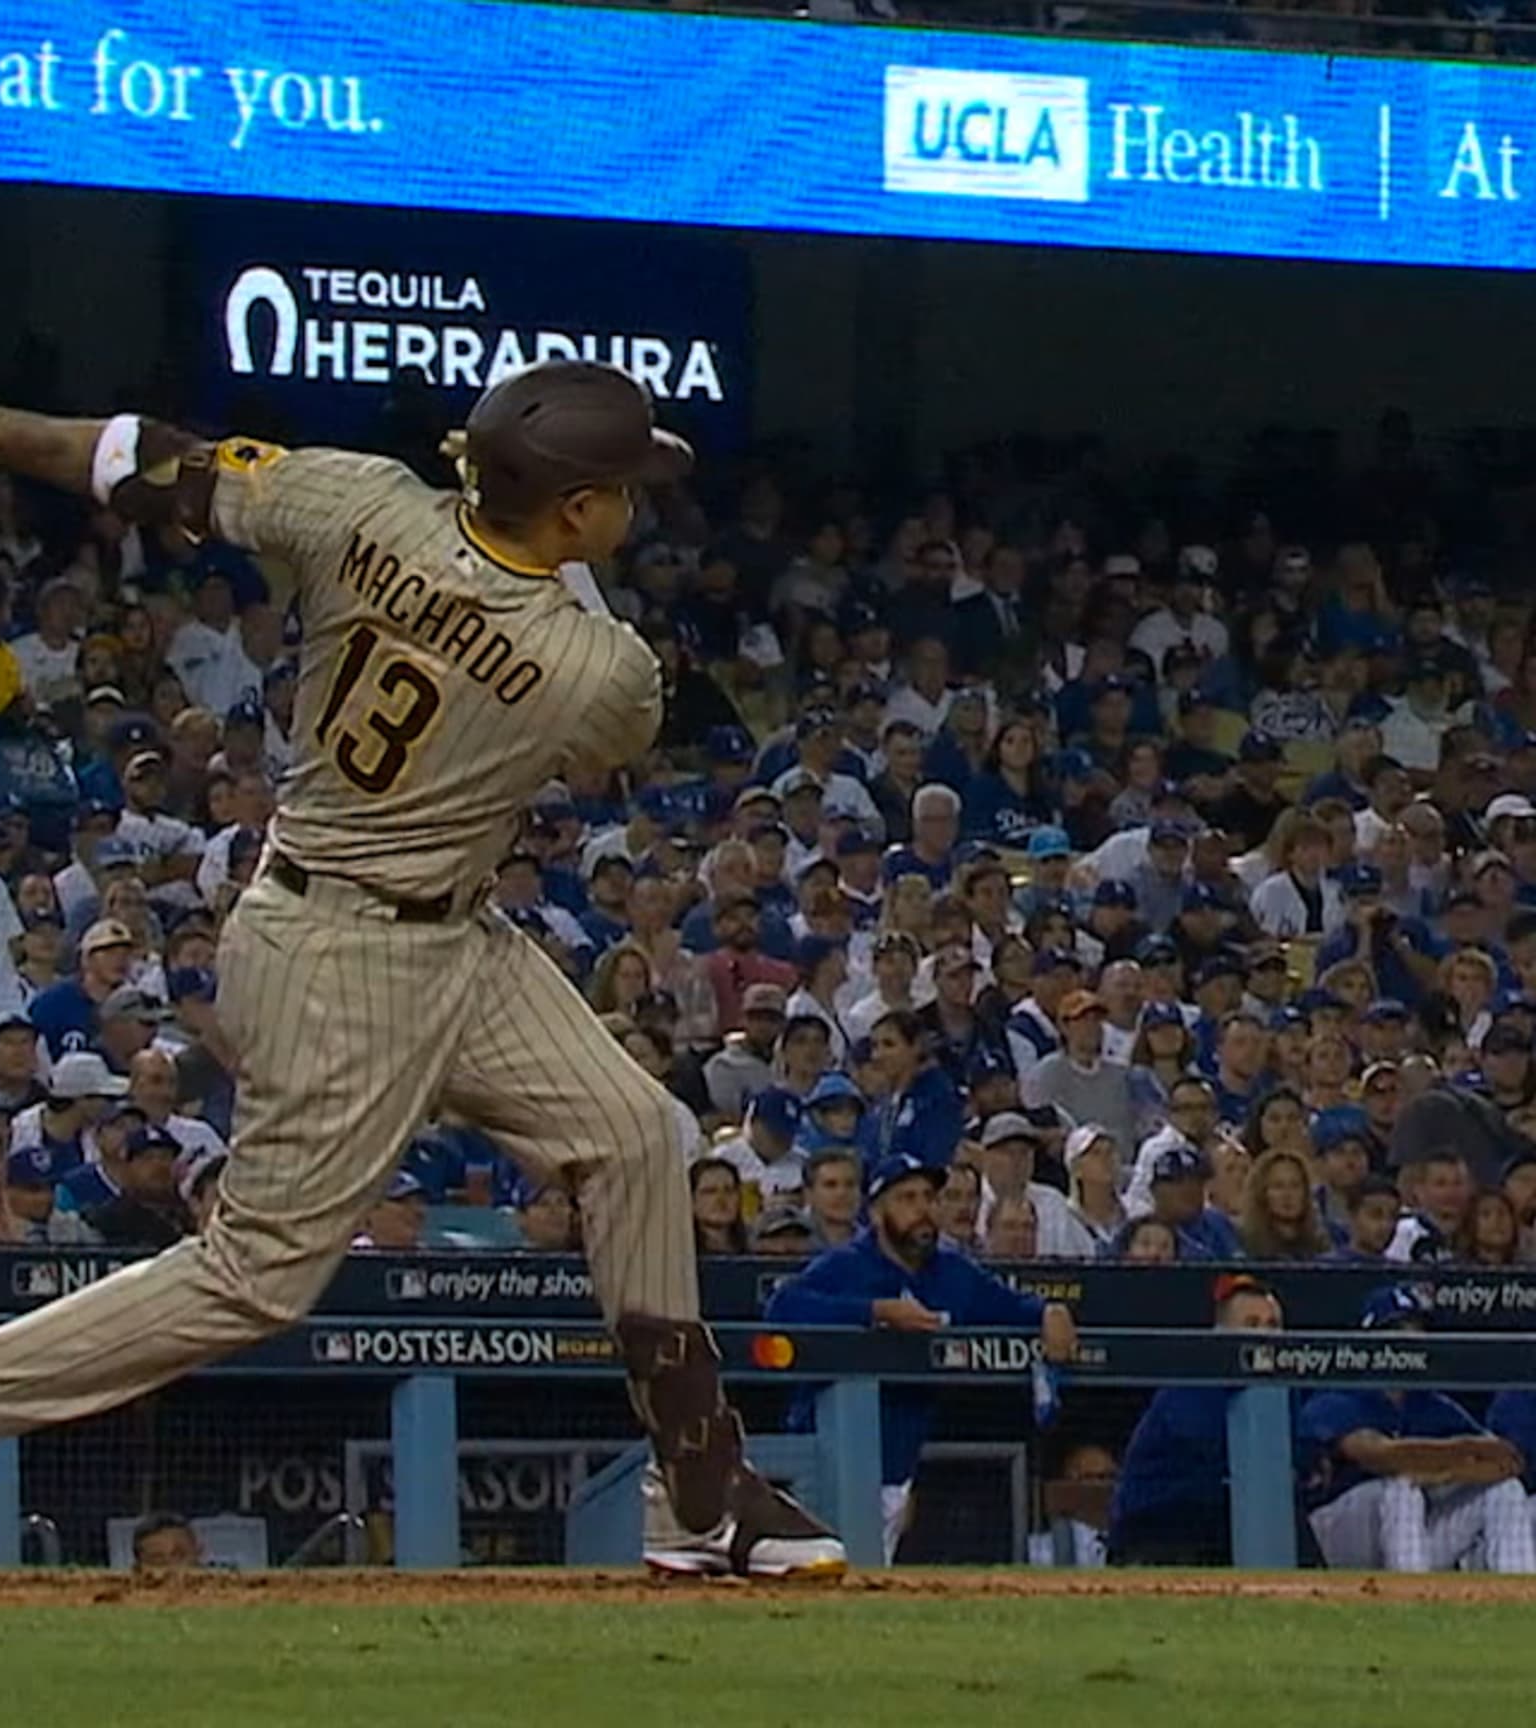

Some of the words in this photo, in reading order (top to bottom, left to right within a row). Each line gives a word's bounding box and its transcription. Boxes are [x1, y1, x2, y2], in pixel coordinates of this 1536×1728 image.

[90, 29, 202, 121] for
[224, 65, 383, 150] you.
[912, 98, 1063, 168] UCLA
[1106, 104, 1324, 192] Health
[1438, 122, 1521, 200] At
[302, 267, 486, 312] TEQUILA
[337, 534, 543, 705] MACHADO
[315, 621, 443, 796] 13
[429, 1267, 496, 1301] enjoy
[498, 1266, 537, 1296] the
[1435, 1279, 1498, 1312] enjoy
[353, 1330, 555, 1363] POSTSEASON
[970, 1337, 1045, 1371] NLDS
[1276, 1345, 1332, 1374] enjoy
[1335, 1345, 1371, 1370] the
